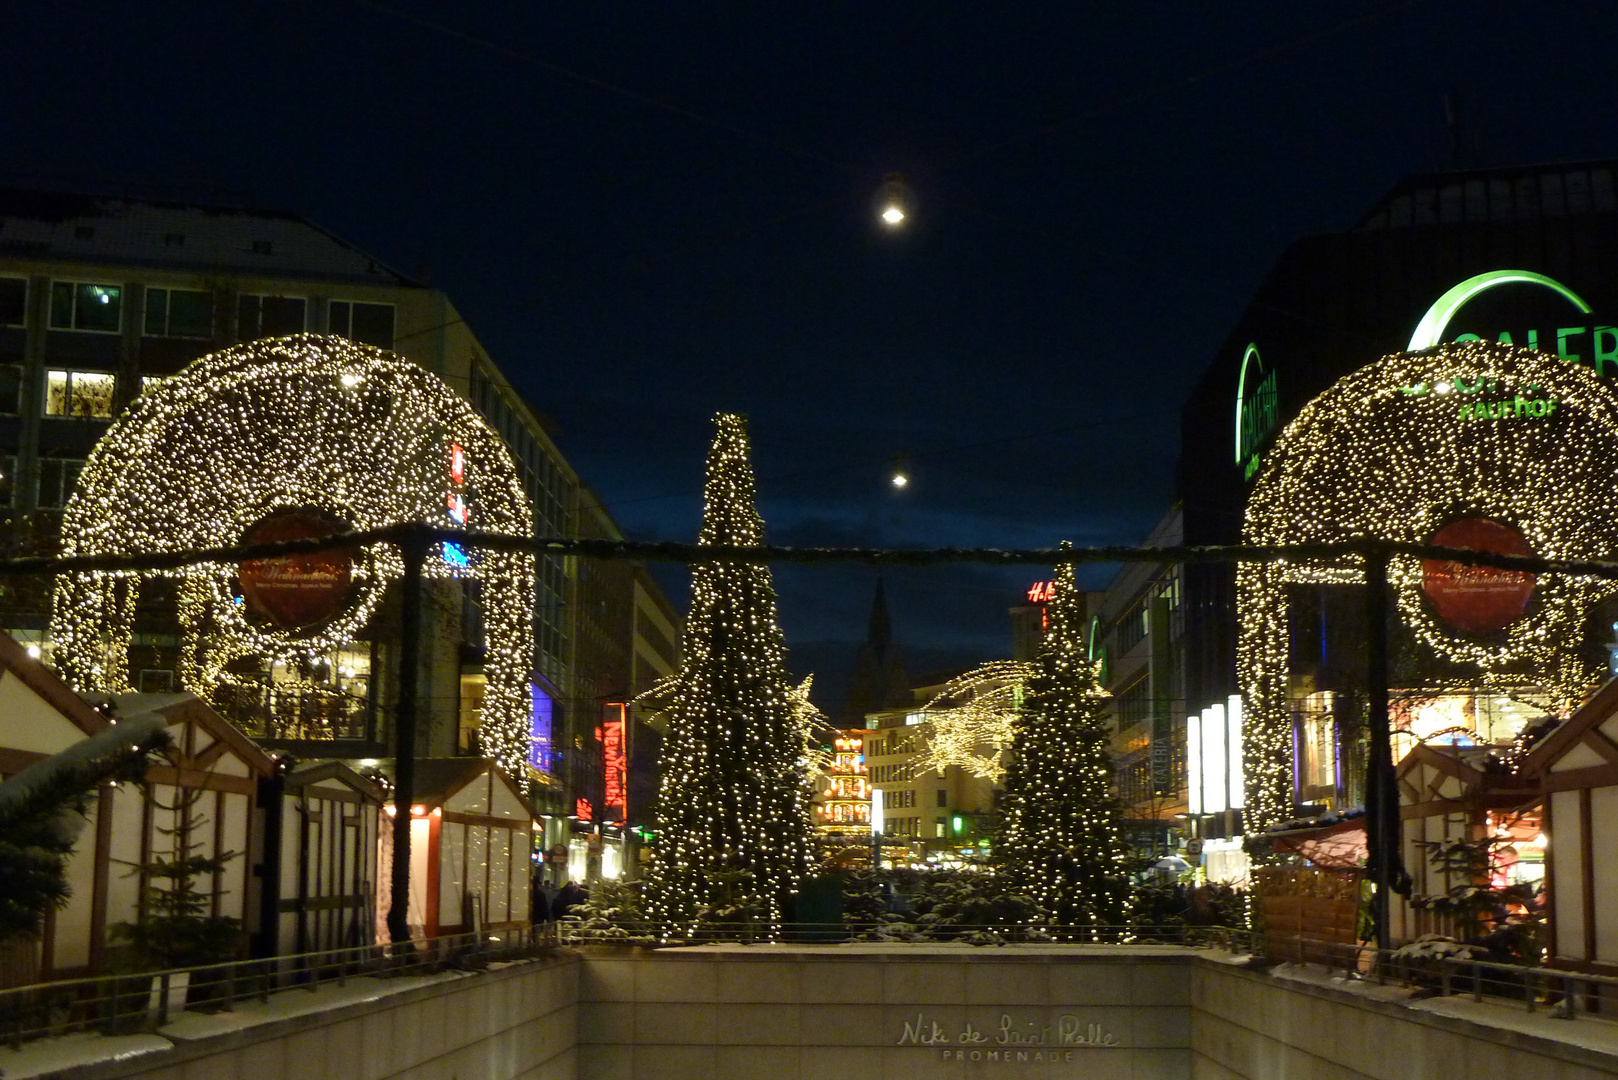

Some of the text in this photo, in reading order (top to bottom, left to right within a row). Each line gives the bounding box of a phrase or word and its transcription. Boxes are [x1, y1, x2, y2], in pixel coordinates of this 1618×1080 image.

[896, 1012, 950, 1045] Niki
[958, 1022, 988, 1044] de
[995, 1013, 1052, 1045] Saint
[942, 1050, 1073, 1062] PROMENADE
